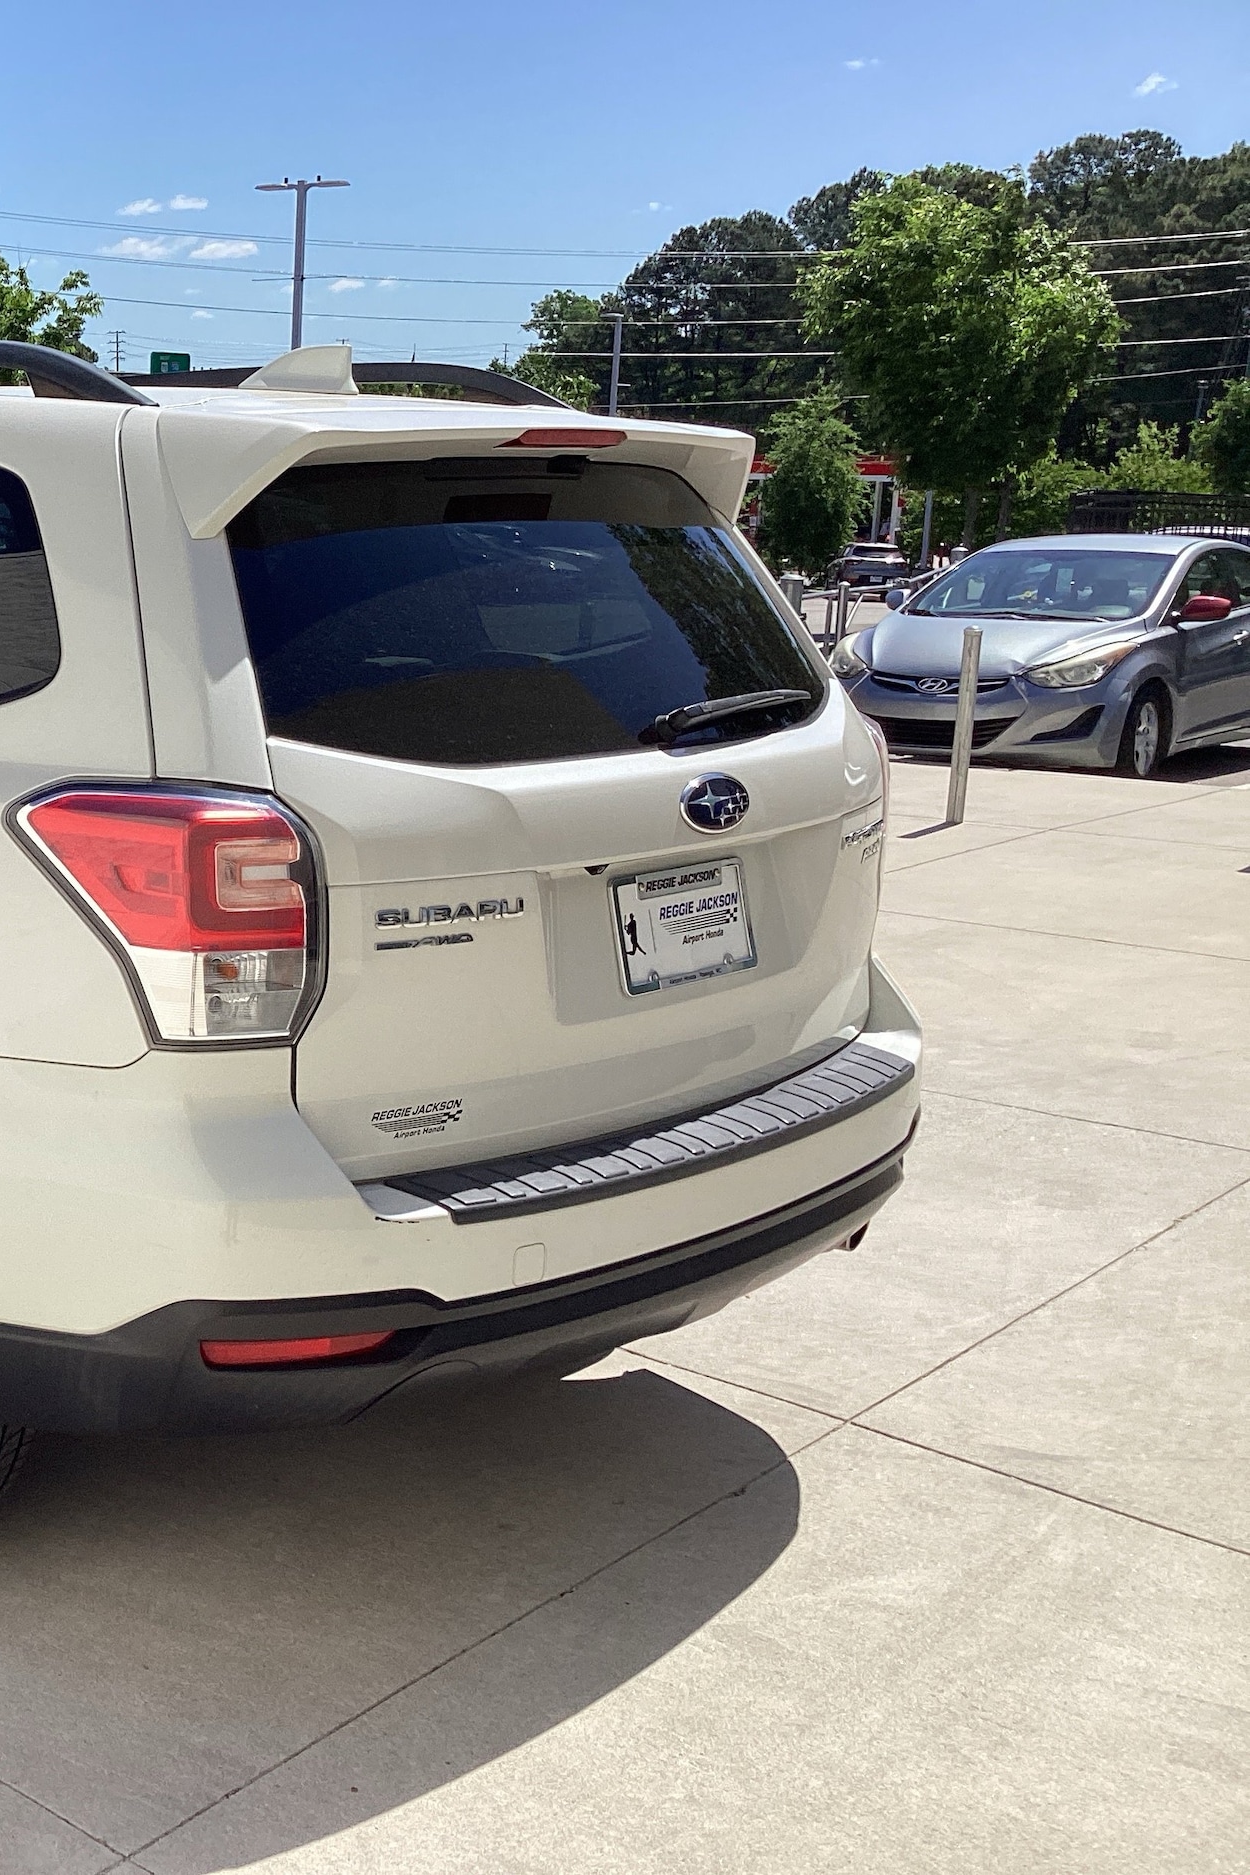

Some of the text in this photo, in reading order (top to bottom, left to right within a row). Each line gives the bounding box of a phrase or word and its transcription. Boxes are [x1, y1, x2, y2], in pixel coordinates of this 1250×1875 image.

[645, 870, 716, 892] REGGIE JACKSON
[375, 897, 525, 930] SUBARU
[659, 891, 738, 920] REGGIE JACKSON
[682, 928, 724, 945] Airport Honda
[371, 1098, 463, 1121] REGGIE JACKSON
[393, 1125, 445, 1139] Airport Honda
